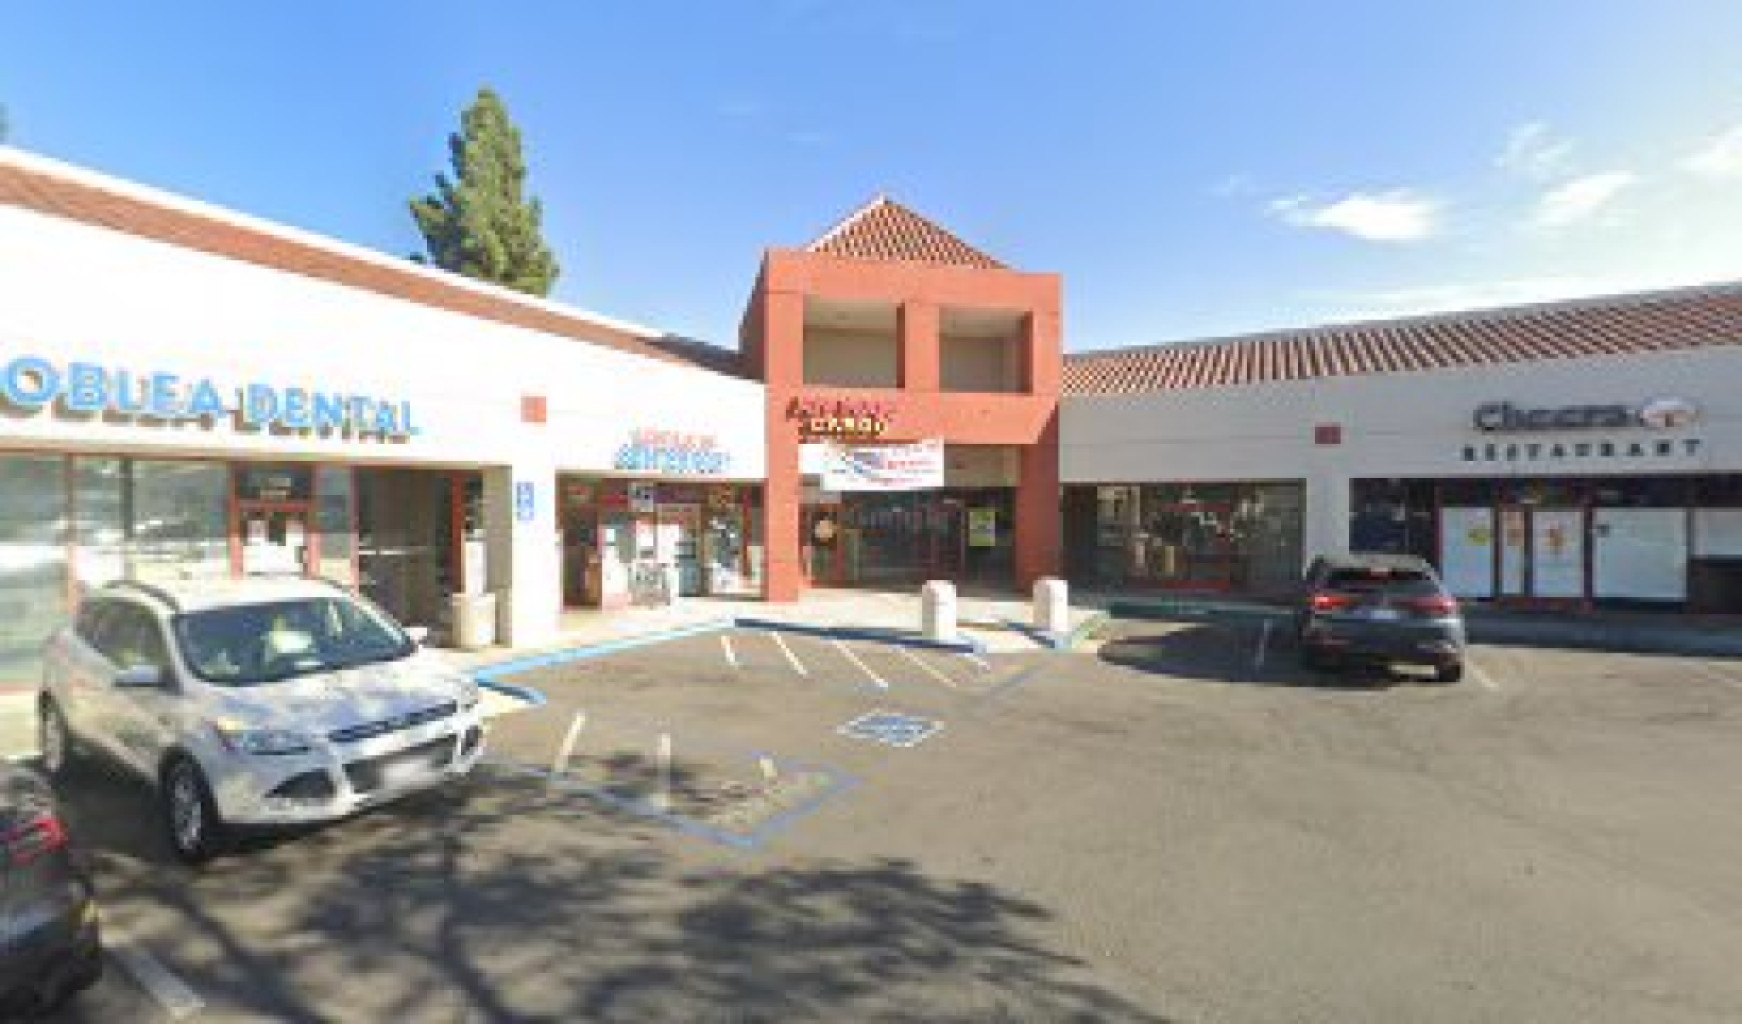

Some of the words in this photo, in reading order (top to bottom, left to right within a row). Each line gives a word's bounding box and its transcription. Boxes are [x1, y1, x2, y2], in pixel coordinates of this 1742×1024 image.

[1, 355, 229, 419] OBLEA
[243, 382, 421, 437] DENTAL
[1461, 438, 1703, 462] RESTAURANT
